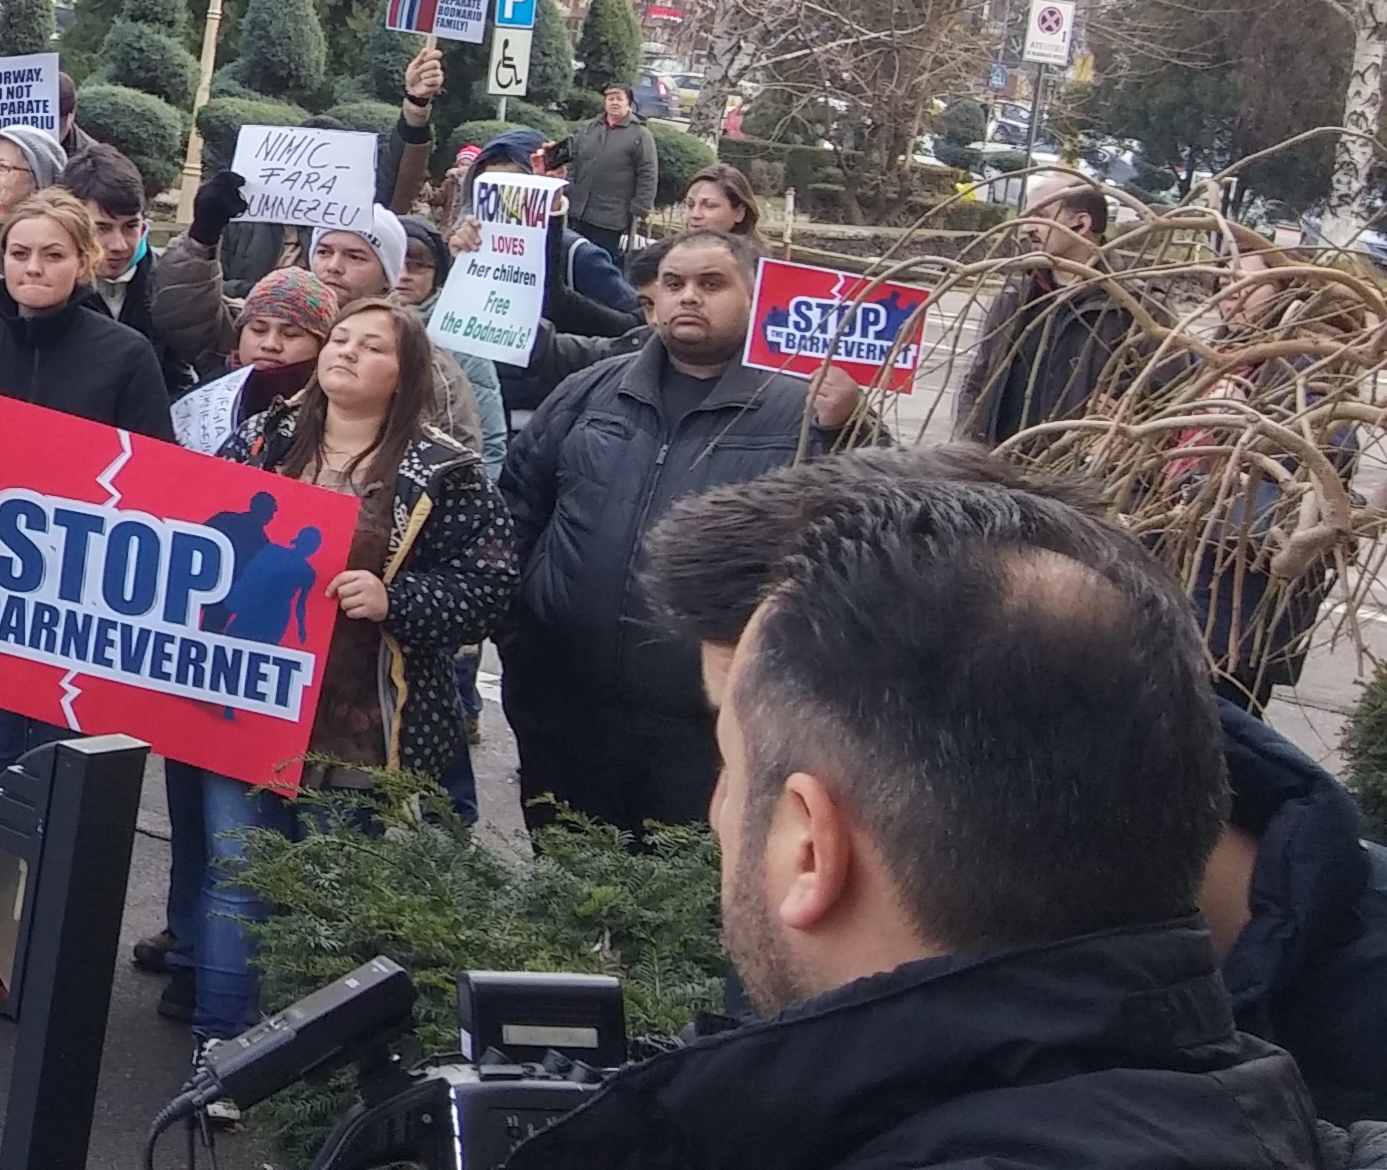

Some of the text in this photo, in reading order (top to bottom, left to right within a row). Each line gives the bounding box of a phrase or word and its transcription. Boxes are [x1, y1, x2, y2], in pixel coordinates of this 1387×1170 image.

[435, 17, 468, 32] FAMILY!
[6, 84, 33, 100] NOT
[255, 130, 331, 168] NIMIC
[259, 168, 337, 195] FARA
[246, 193, 361, 227] UMNEZEU
[477, 181, 549, 229] ROMANIA
[491, 234, 525, 256] LOVES
[466, 258, 536, 286] her children
[483, 290, 510, 316] Free
[439, 311, 463, 335] the
[792, 300, 882, 339] STOP
